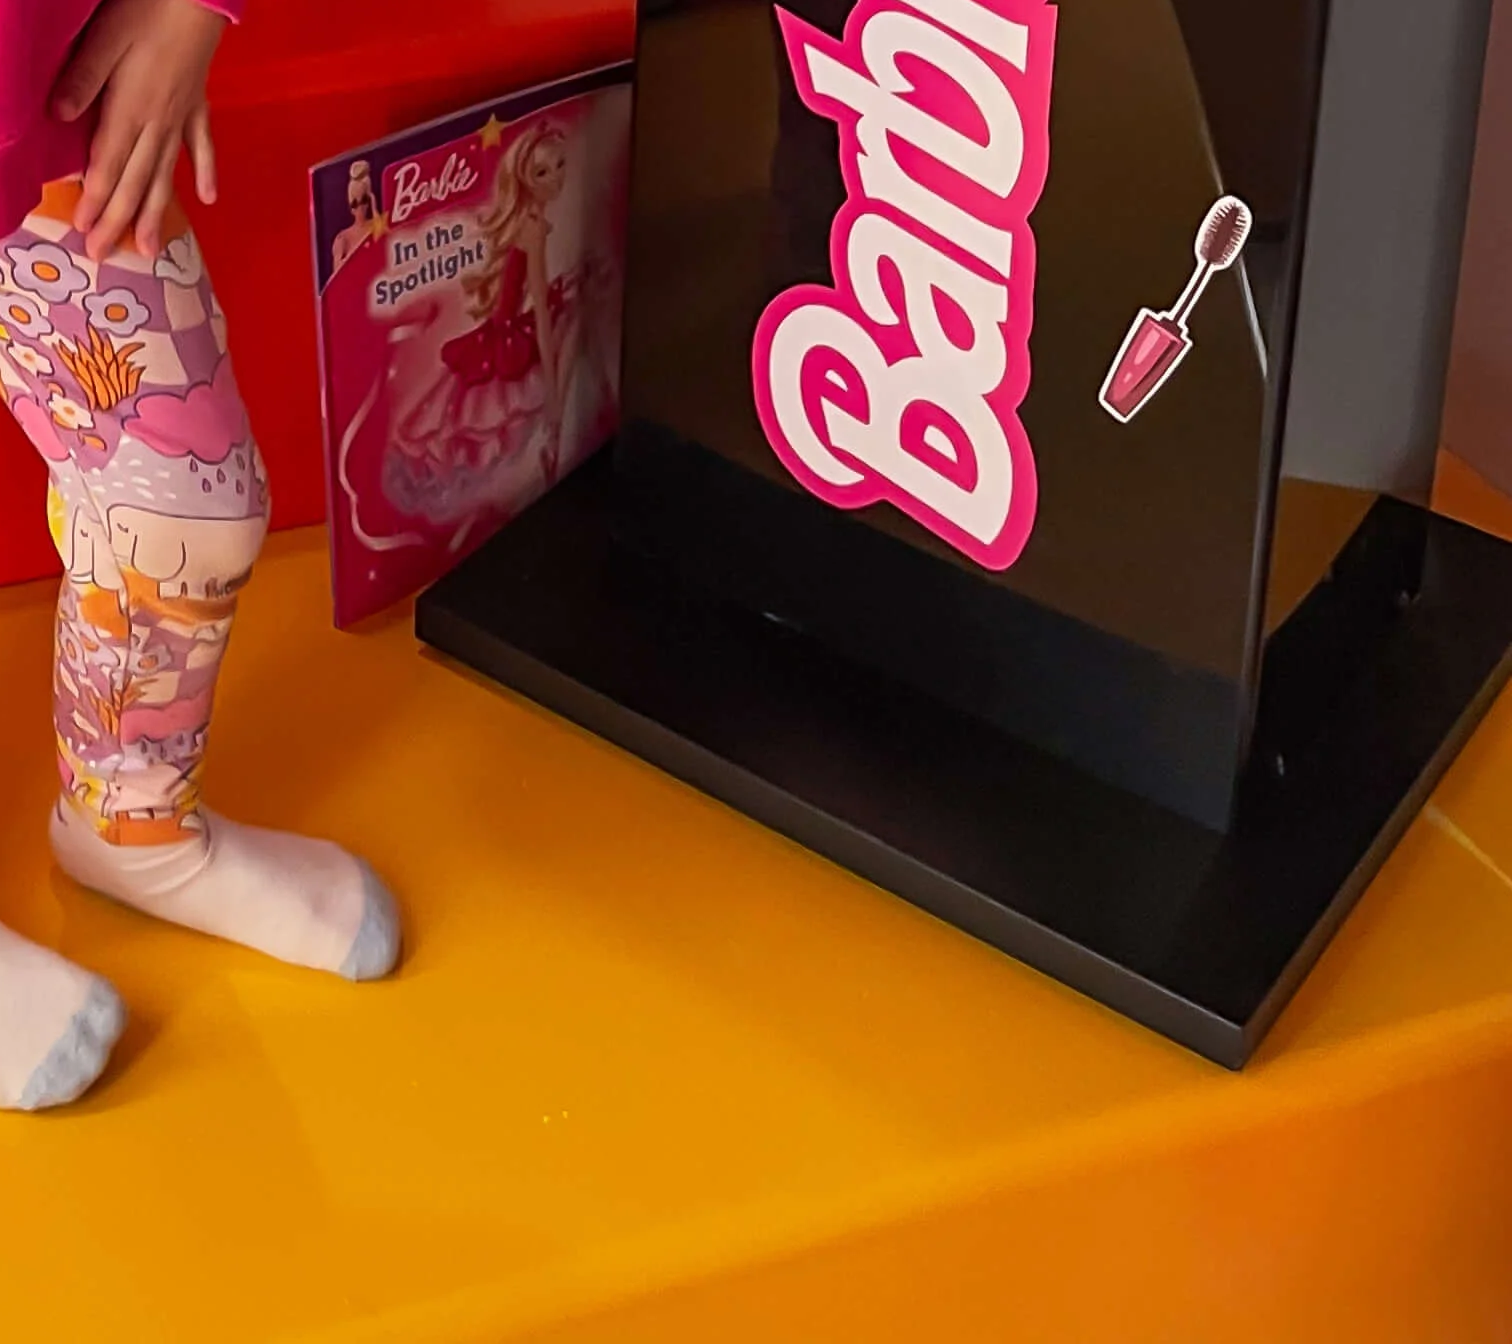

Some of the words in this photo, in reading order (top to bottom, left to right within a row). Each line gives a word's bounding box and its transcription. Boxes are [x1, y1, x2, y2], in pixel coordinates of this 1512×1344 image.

[391, 153, 479, 223] Barbie
[376, 241, 483, 305] Spotlight
[394, 242, 418, 265] In
[426, 223, 463, 250] the
